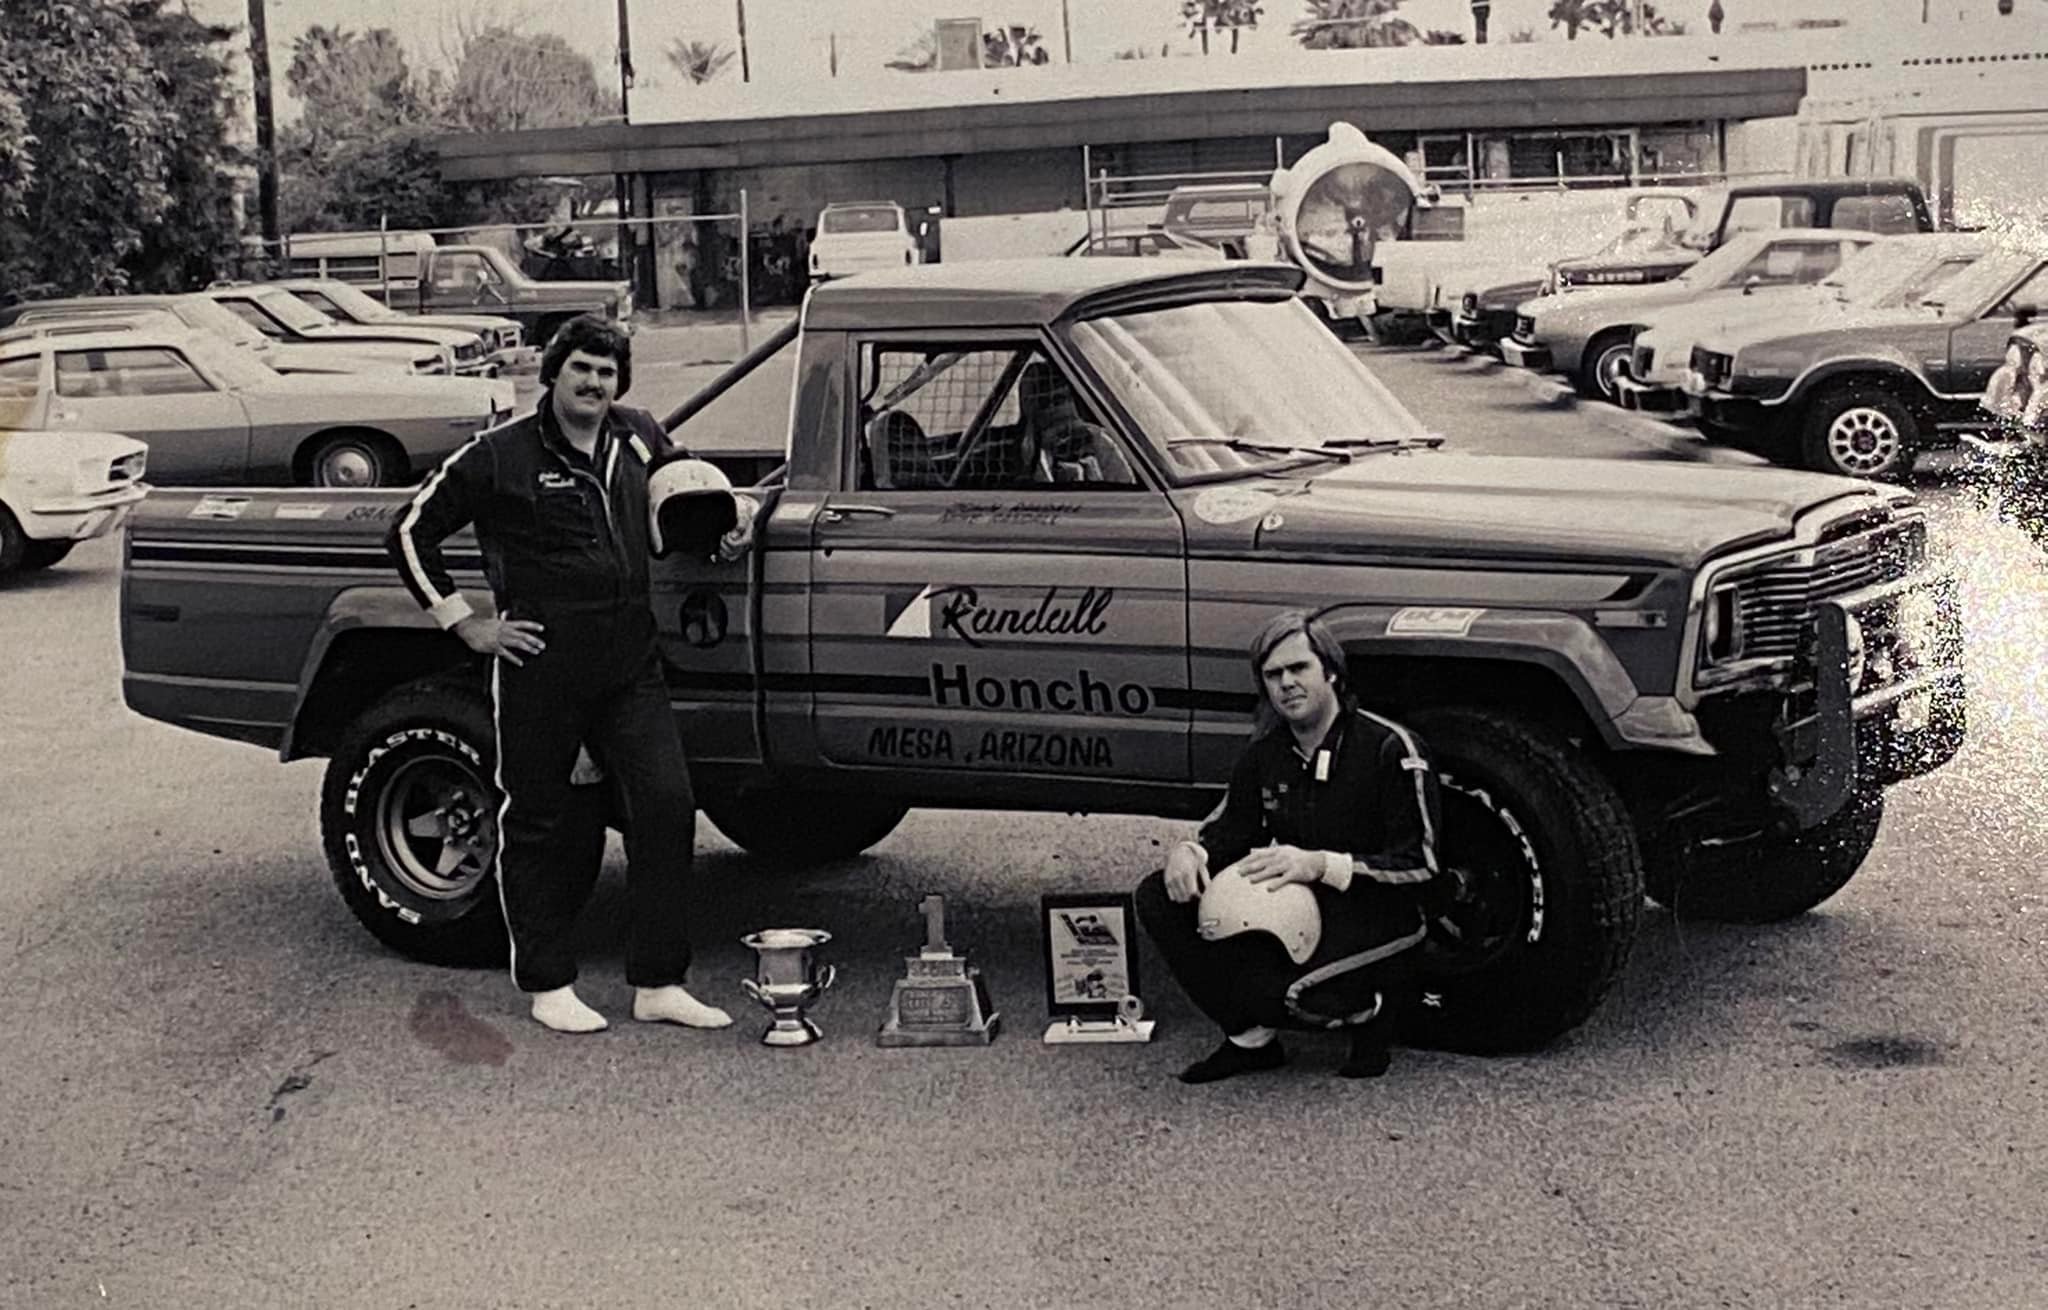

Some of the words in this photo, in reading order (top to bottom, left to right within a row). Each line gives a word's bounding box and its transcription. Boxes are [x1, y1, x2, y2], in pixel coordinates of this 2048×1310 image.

[923, 585, 1114, 649] Randall
[930, 662, 1149, 715] Honcho
[344, 728, 481, 816] BLASTER
[979, 730, 1114, 768] ARIZONA
[345, 832, 422, 925] SAND
[1439, 773, 1544, 943] LASTER
